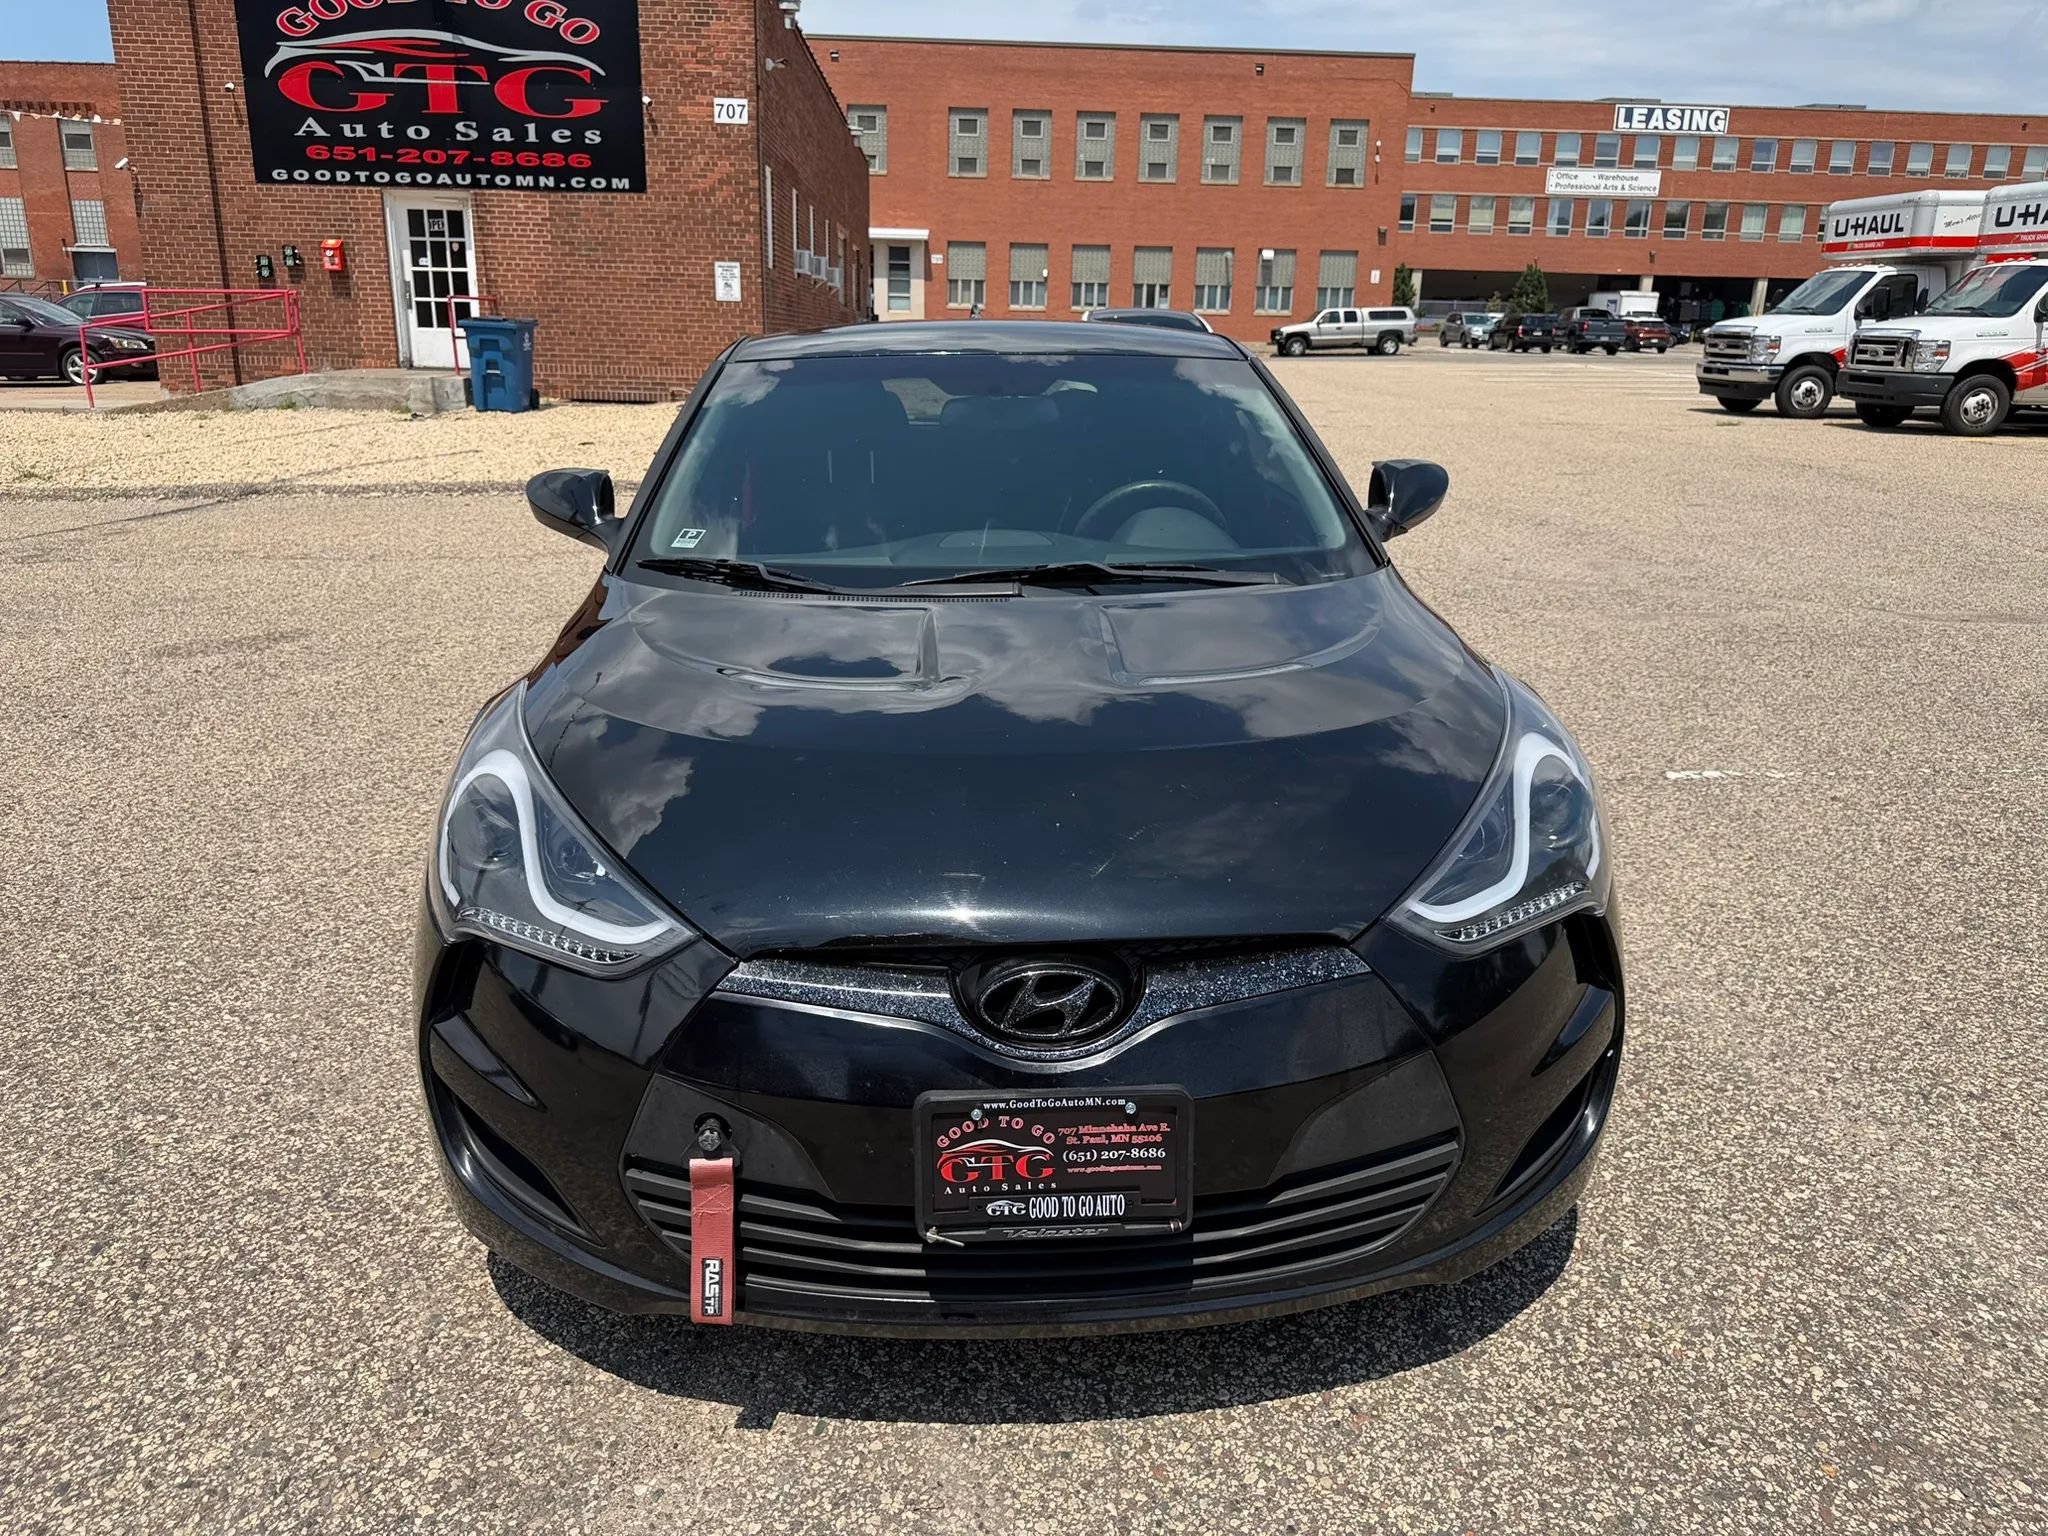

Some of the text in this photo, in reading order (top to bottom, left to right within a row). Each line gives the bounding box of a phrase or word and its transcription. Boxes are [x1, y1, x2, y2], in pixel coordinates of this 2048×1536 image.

[276, 0, 600, 45] GO GO
[278, 61, 609, 119] GTG
[715, 104, 746, 119] 707
[1617, 107, 1726, 132] LEASING
[294, 116, 602, 144] Auto Sales
[306, 145, 592, 168] 651-207-8686
[272, 168, 630, 190] GOODTOGOAUTOMN.COM
[1555, 182, 1600, 191] Professional
[1628, 184, 1657, 192] Science
[1598, 173, 1639, 181] Warehouse
[1834, 213, 1905, 238] U-HAUL
[983, 1098, 1125, 1109] www.GoodToGoAutoMN.com
[937, 1116, 1056, 1148] GOOD TO GO
[1058, 1127, 1077, 1136] 707
[1138, 1123, 1158, 1132] Ave
[1160, 1122, 1171, 1132] E.
[1066, 1133, 1163, 1144] St. Paul, MN 55106
[1062, 1147, 1166, 1162] (651) 207-8686
[938, 1154, 1056, 1183] GTG
[944, 1181, 1056, 1195] Auto Sales
[986, 1194, 1125, 1218] GTG GOOD TO GO AUTO
